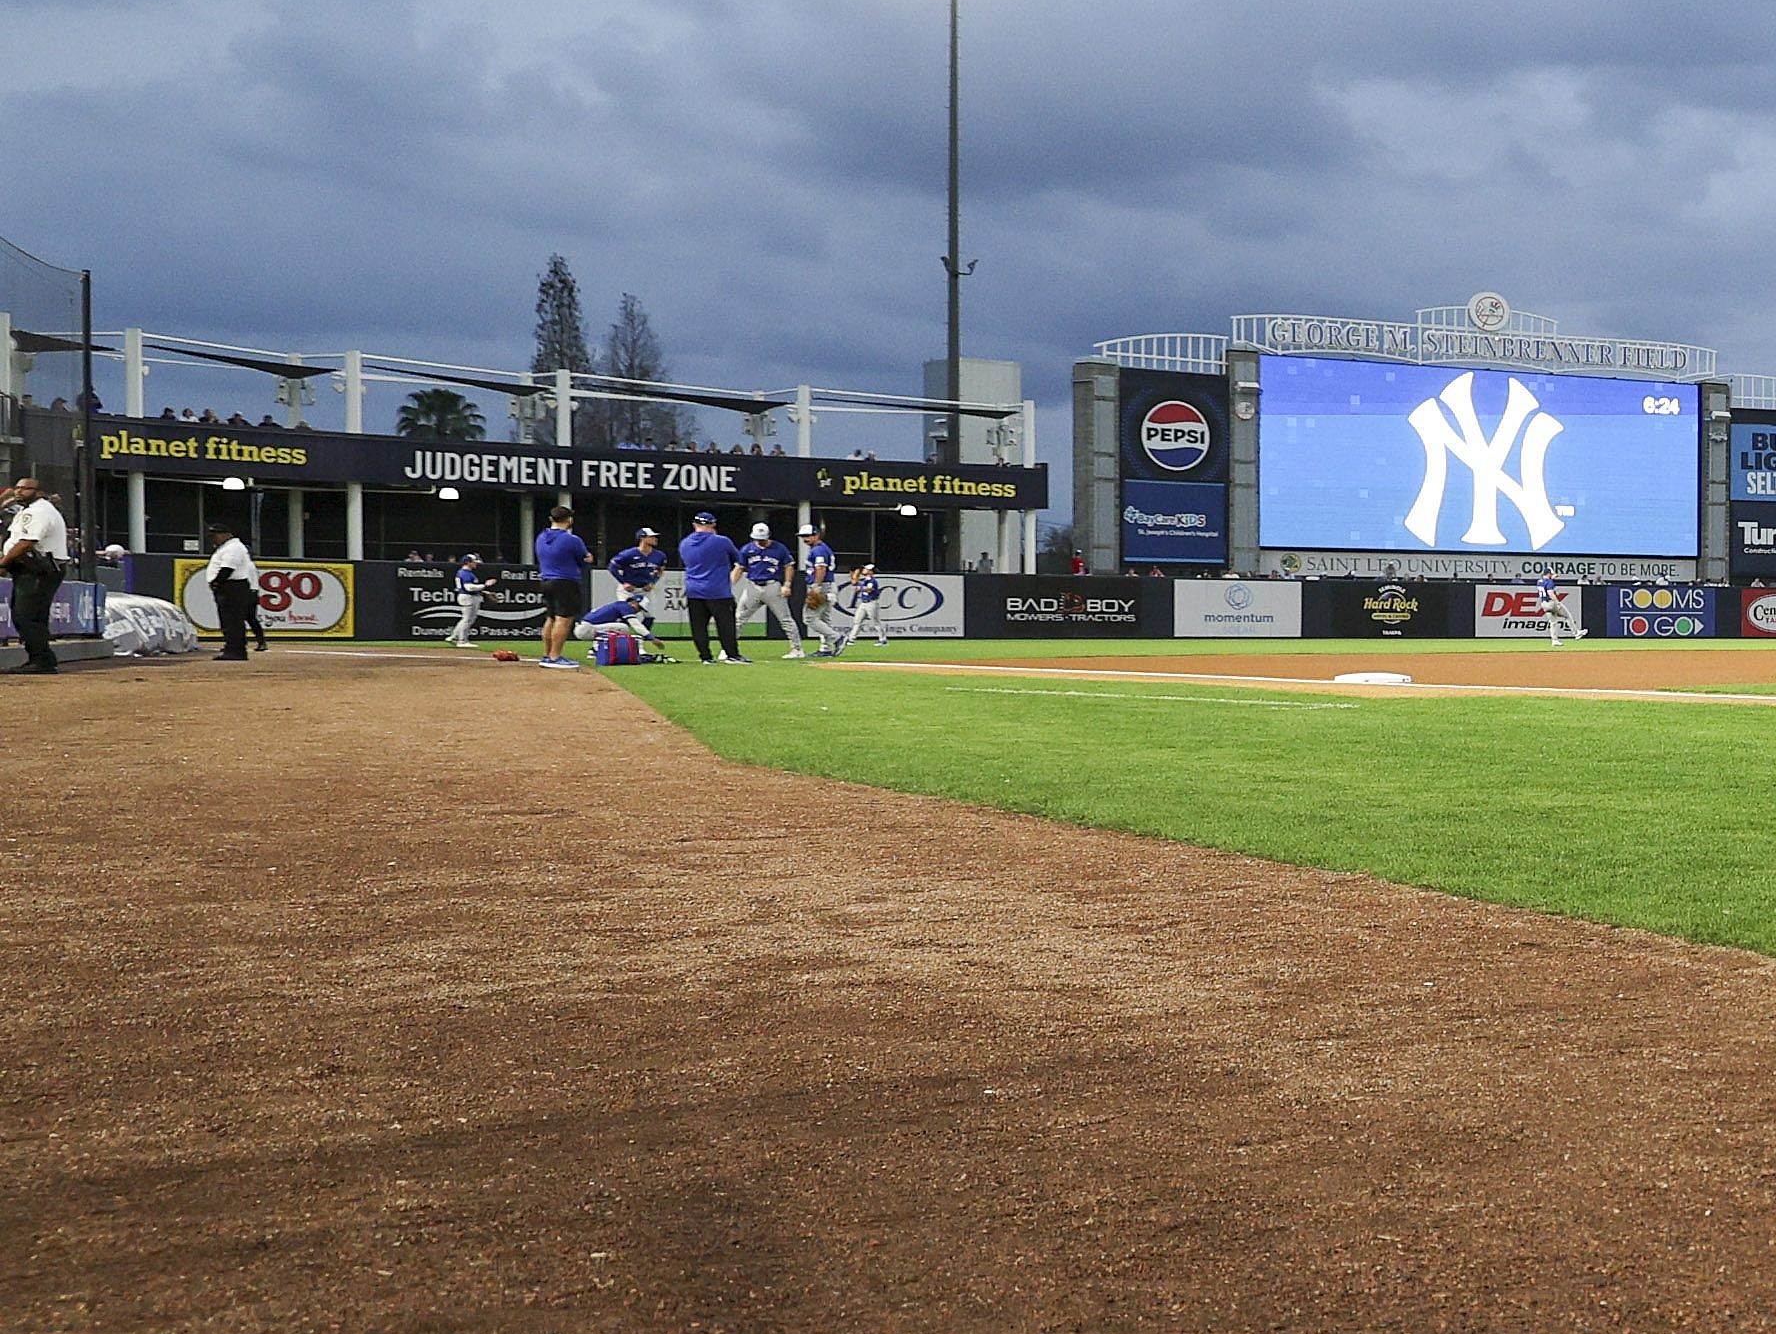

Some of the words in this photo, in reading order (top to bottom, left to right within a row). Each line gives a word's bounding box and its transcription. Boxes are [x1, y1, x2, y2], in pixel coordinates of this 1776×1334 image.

[1270, 319, 1379, 349] GEORGE
[1383, 327, 1416, 353] M.
[1424, 329, 1613, 365] STEINBRENNER
[1618, 344, 1689, 369] FIELD
[1642, 396, 1681, 416] 6:24
[1146, 427, 1205, 445] PEPSI
[101, 430, 198, 459] planet
[205, 436, 308, 465] fitness
[404, 449, 573, 486] JUDGEMENT
[581, 459, 655, 489] FREE
[662, 464, 737, 493] ZONE
[1404, 371, 1566, 551] NY
[843, 470, 926, 495] planet
[930, 475, 1017, 498] fitness
[397, 567, 444, 578] Rentals
[1306, 556, 1361, 572] SAINT
[1407, 558, 1512, 574] UNIVERSITY.
[1521, 561, 1596, 575] COURAGE
[1600, 562, 1618, 576] TO
[1620, 563, 1637, 576] BE
[1640, 563, 1680, 577] MORE.
[1006, 598, 1057, 612] BAD
[1087, 599, 1136, 613] BOY
[1363, 597, 1391, 611] Hard
[1392, 597, 1419, 612] Rock
[1619, 588, 1705, 609] ROOMS
[1006, 613, 1064, 622] MOWERS
[1069, 613, 1137, 623] TRACTORS
[1204, 612, 1274, 624] momentum
[1620, 615, 1649, 636] TO
[1653, 615, 1695, 636] GO
